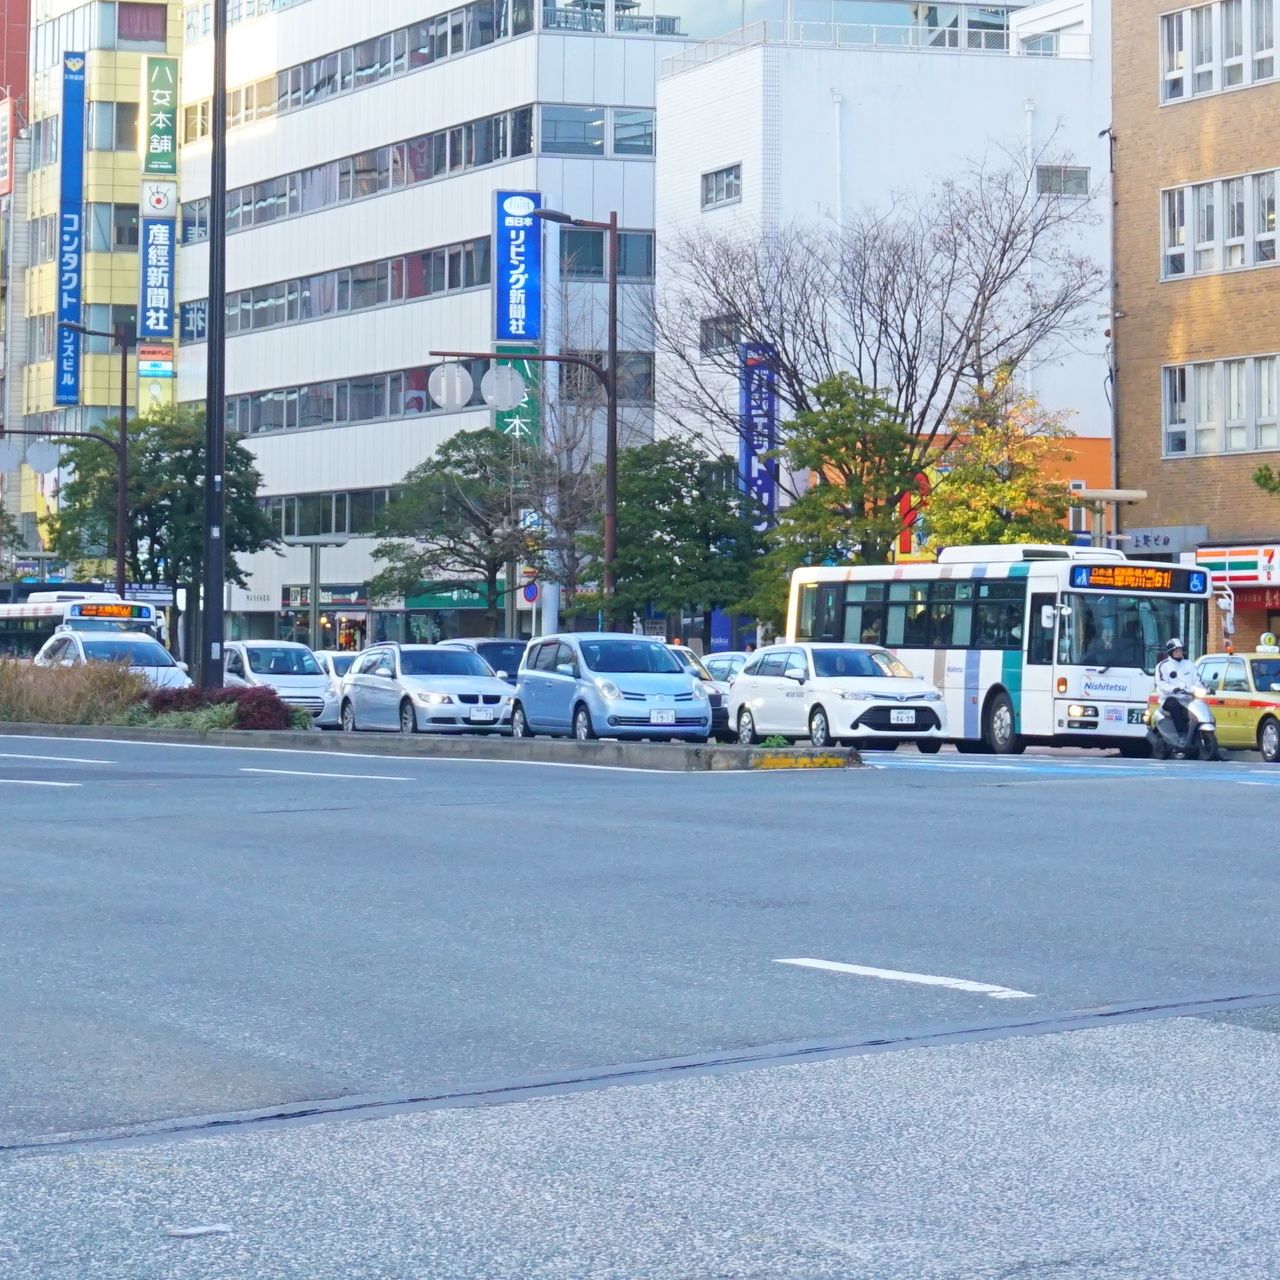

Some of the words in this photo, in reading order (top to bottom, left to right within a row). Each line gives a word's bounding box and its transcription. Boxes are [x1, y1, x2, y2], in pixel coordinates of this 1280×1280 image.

[150, 66, 173, 153] 八女本舗
[62, 213, 79, 309] コンタクト
[509, 229, 528, 335] リビング新聞社
[1083, 681, 1128, 692] Nishitetsu
